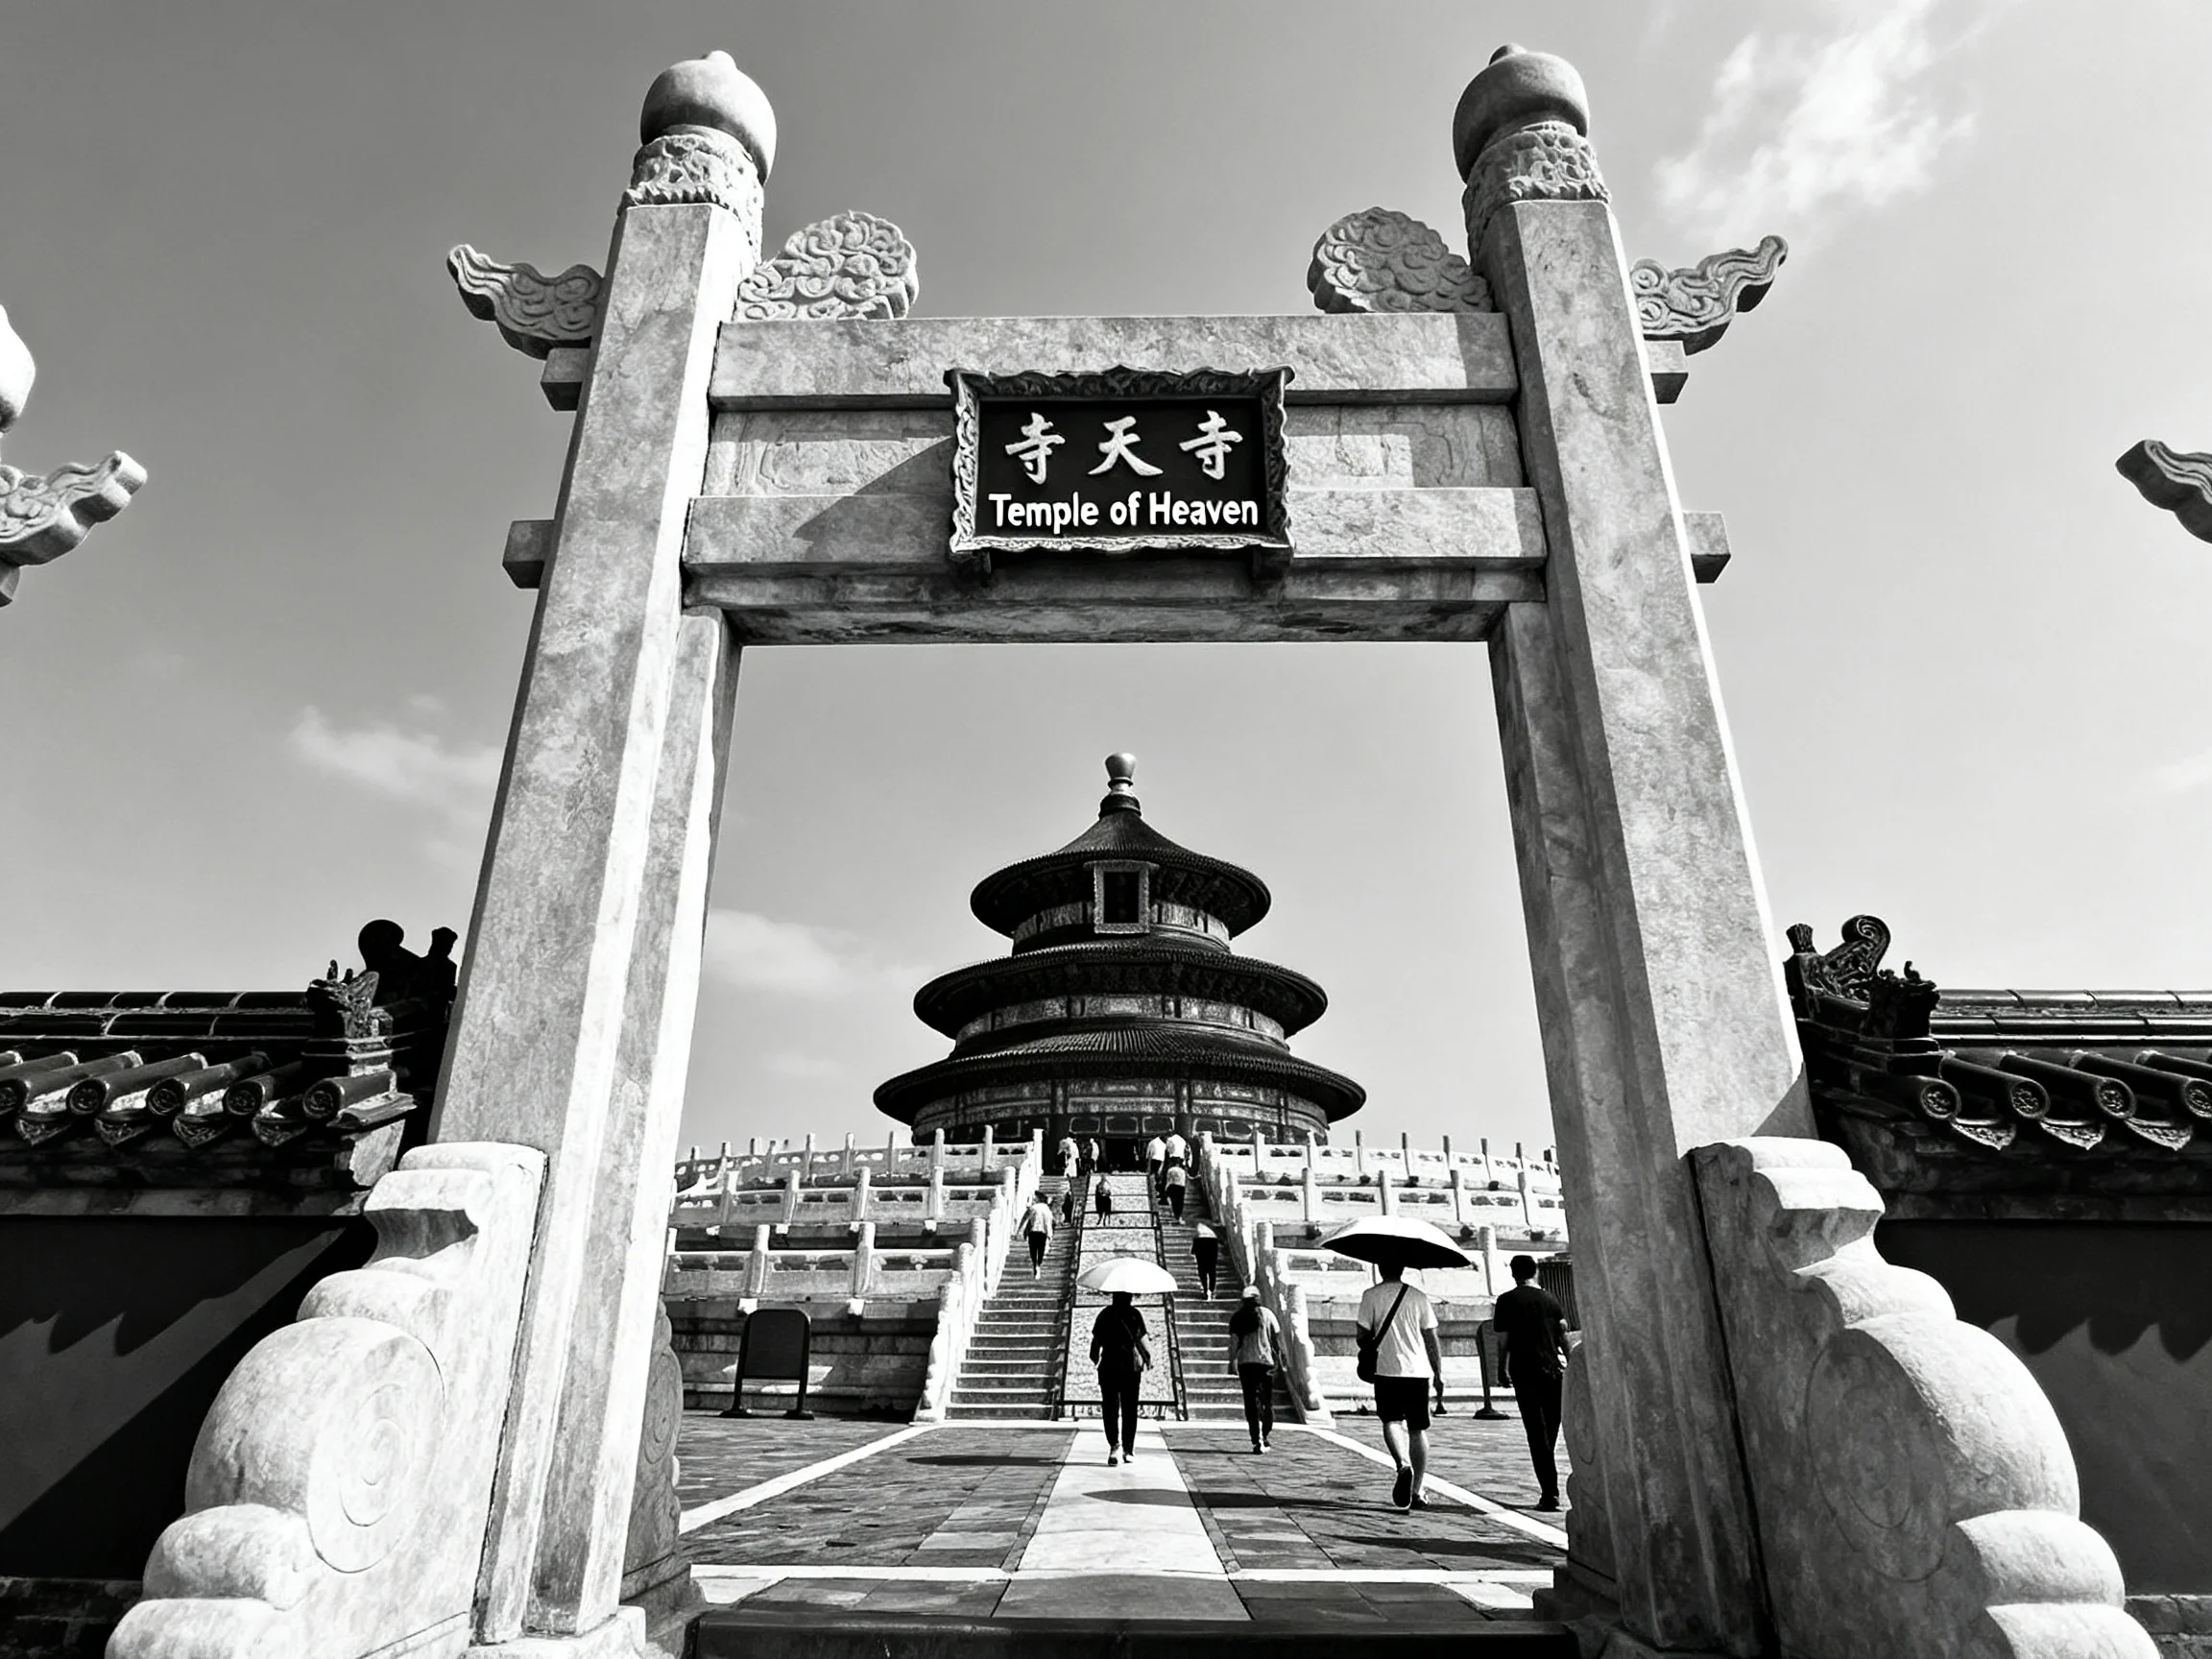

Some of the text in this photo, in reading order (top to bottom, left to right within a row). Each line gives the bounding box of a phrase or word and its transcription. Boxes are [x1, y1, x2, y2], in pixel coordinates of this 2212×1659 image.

[1004, 410, 1243, 484] 寺天寺
[988, 491, 1259, 535] Temple of Heaven
